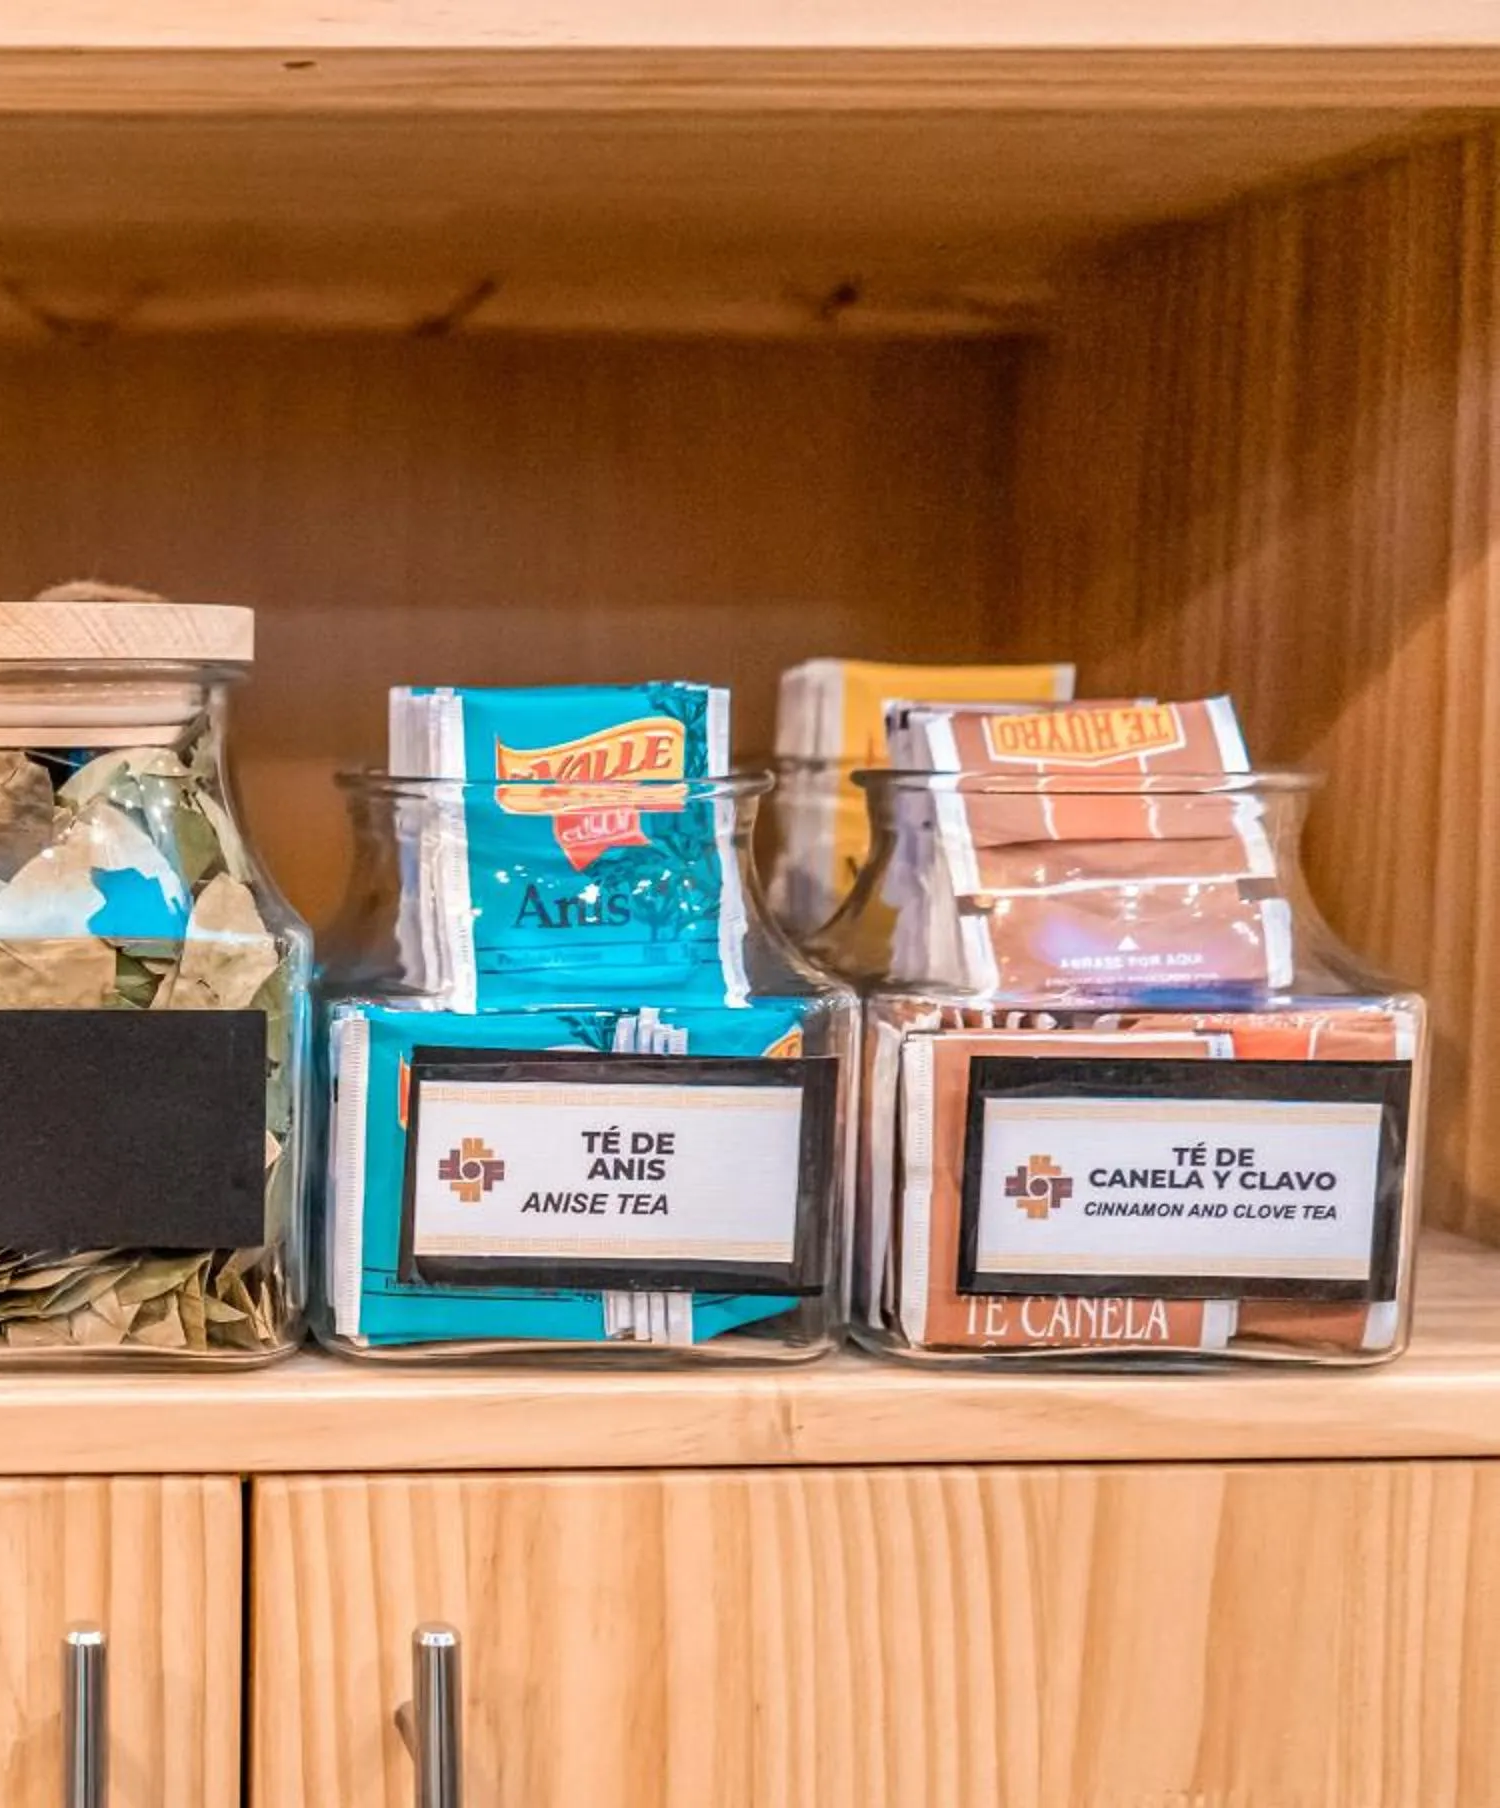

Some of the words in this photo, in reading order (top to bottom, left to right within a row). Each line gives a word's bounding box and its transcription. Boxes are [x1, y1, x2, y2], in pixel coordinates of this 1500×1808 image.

[581, 1126, 621, 1154] TÉ
[631, 1132, 675, 1155] DE
[1172, 1142, 1206, 1167] TÉ
[1216, 1149, 1255, 1167] DE
[587, 1158, 666, 1181] ANIS
[1089, 1169, 1204, 1189] CANELA
[1212, 1171, 1232, 1190] Y
[1239, 1172, 1337, 1191] CLAVO
[521, 1192, 609, 1215] ANISE
[617, 1194, 668, 1215] TEA
[1084, 1202, 1184, 1218] CINNAMON
[1188, 1203, 1228, 1218] AND
[1233, 1204, 1296, 1220] CLOVE
[1302, 1205, 1337, 1220] TEA
[961, 1295, 1008, 1336] TE
[1020, 1295, 1169, 1340] CANELA
